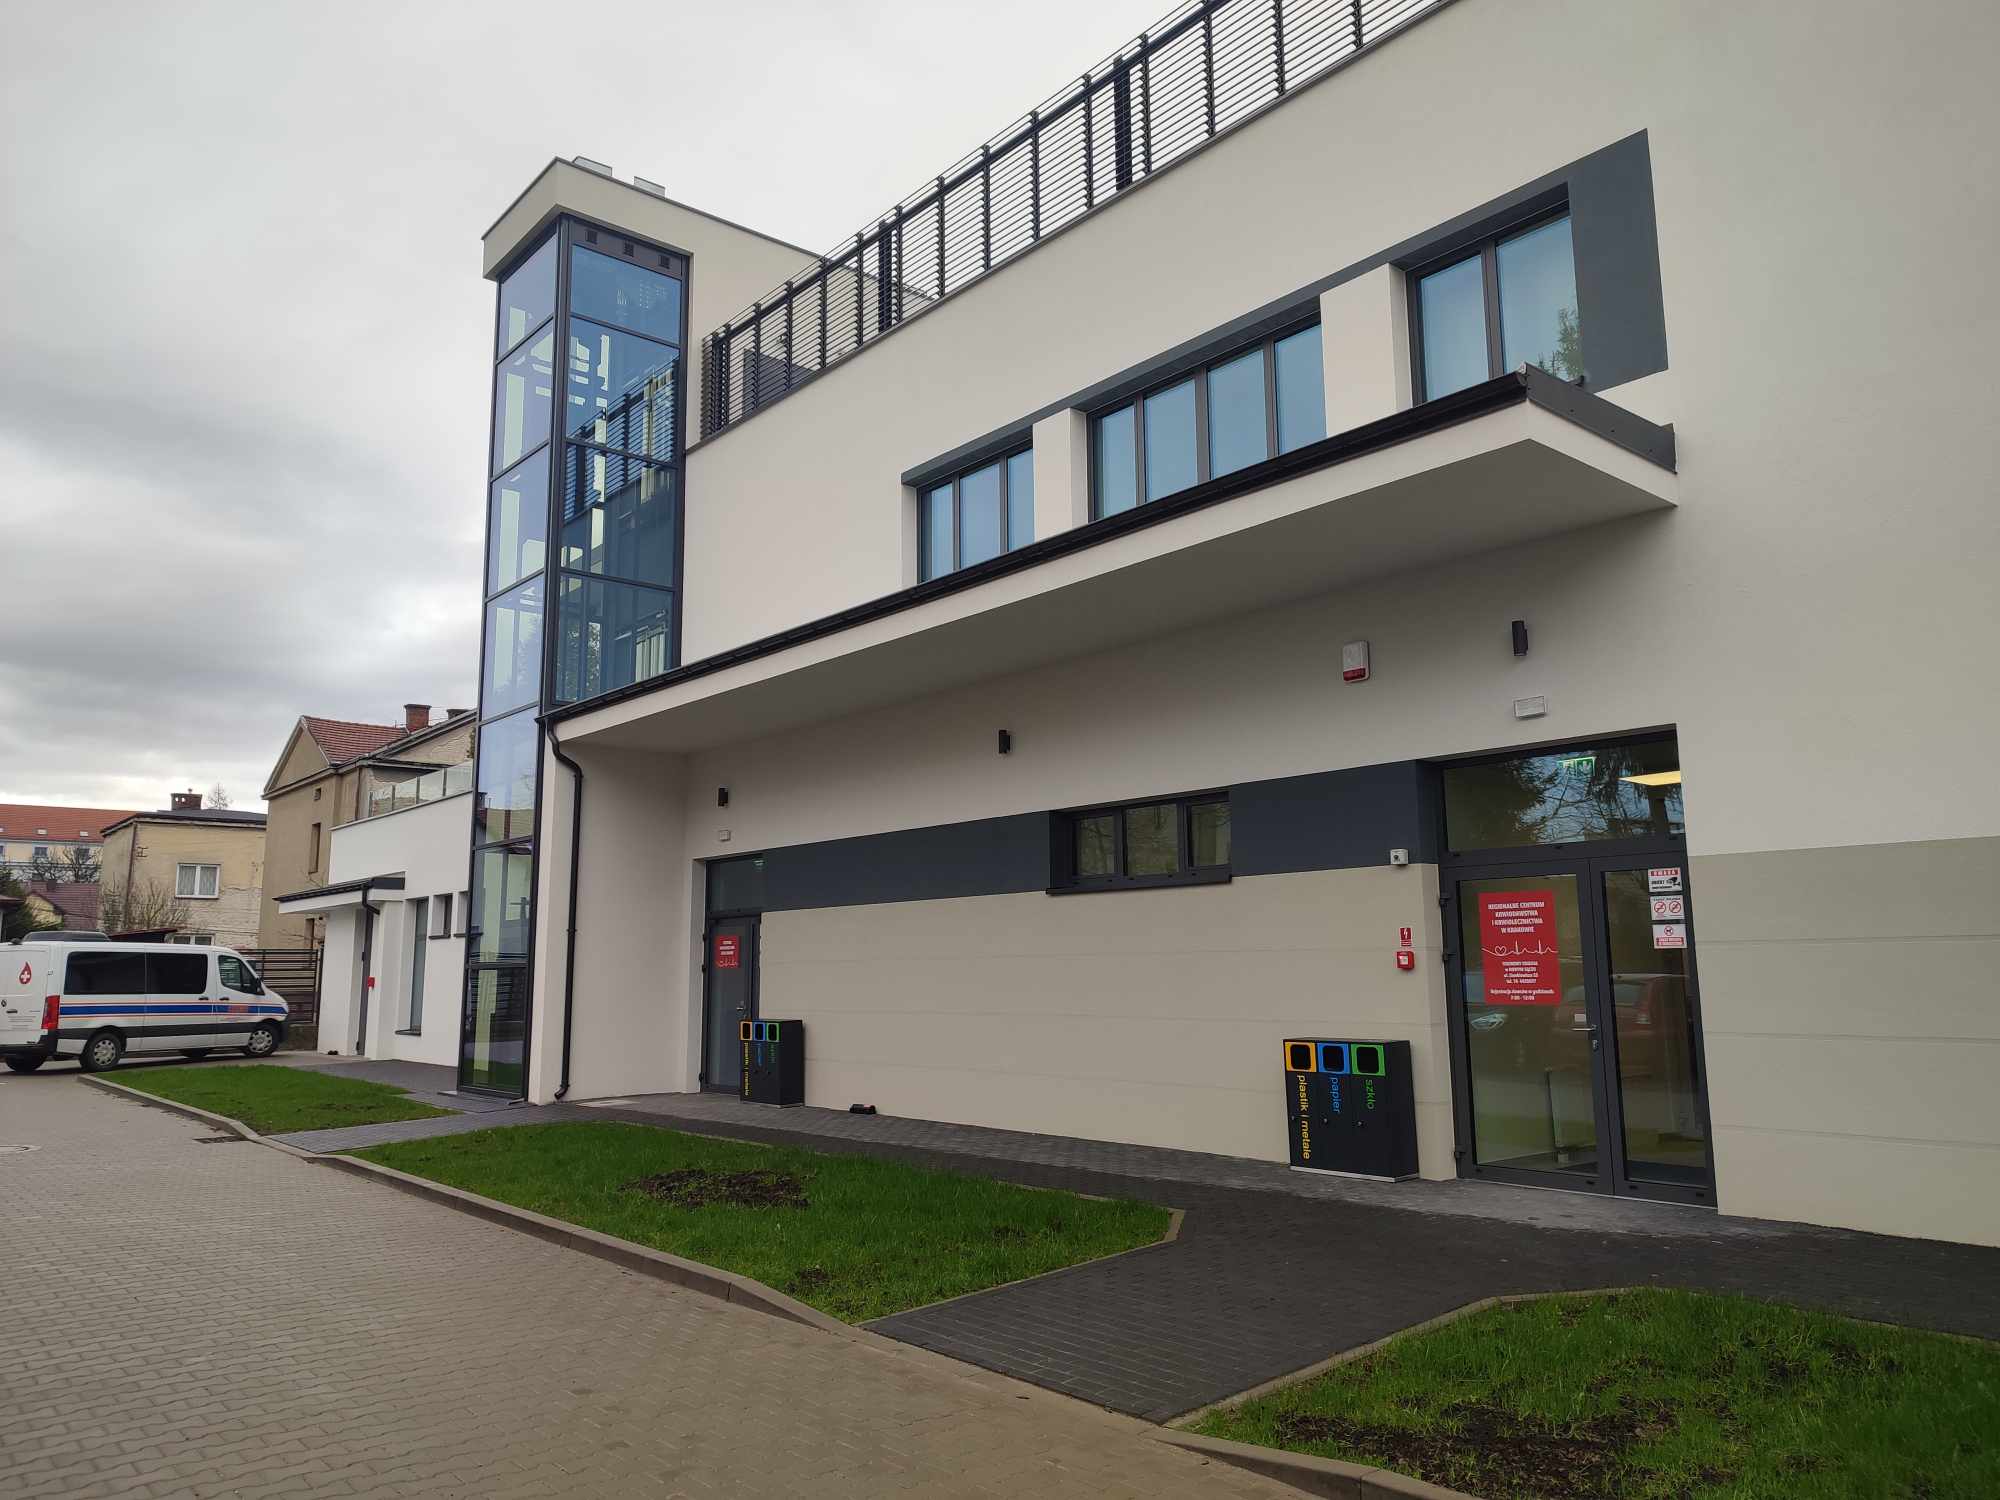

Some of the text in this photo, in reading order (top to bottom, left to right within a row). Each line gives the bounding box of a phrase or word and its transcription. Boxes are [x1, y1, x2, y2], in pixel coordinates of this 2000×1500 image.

[1297, 1074, 1309, 1112] plastik
[1329, 1077, 1341, 1114] papier
[1301, 1120, 1312, 1160] metale
